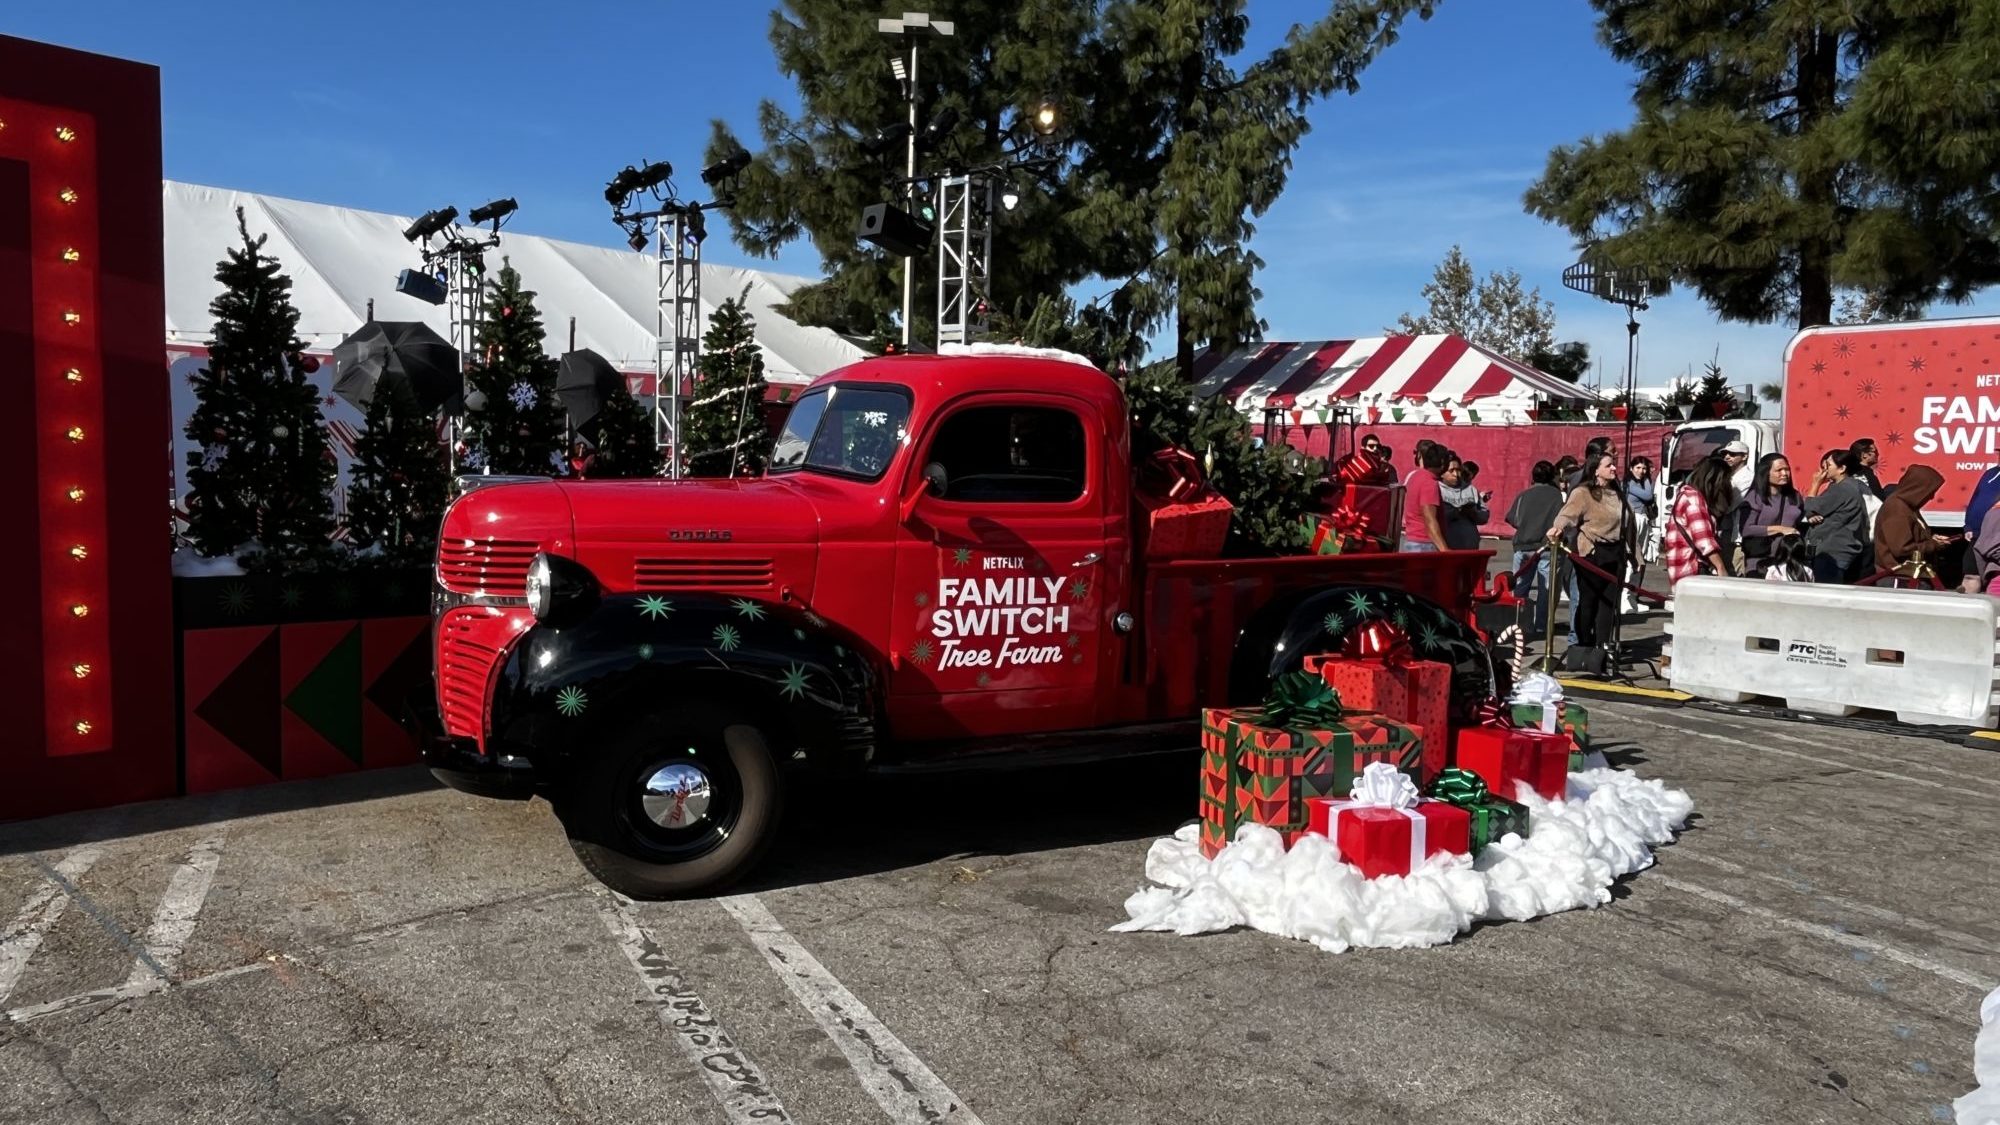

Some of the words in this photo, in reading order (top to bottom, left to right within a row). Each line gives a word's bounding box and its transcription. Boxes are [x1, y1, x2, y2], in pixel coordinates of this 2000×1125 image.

[1913, 426, 2000, 454] SWI
[1956, 462, 1985, 471] NOW
[983, 556, 1024, 570] NETFLIX
[939, 576, 1067, 606] FAMILY
[931, 606, 1069, 638] SWITCH
[937, 639, 992, 671] Tree
[995, 637, 1063, 669] Farm
[1790, 643, 1816, 654] PTC
